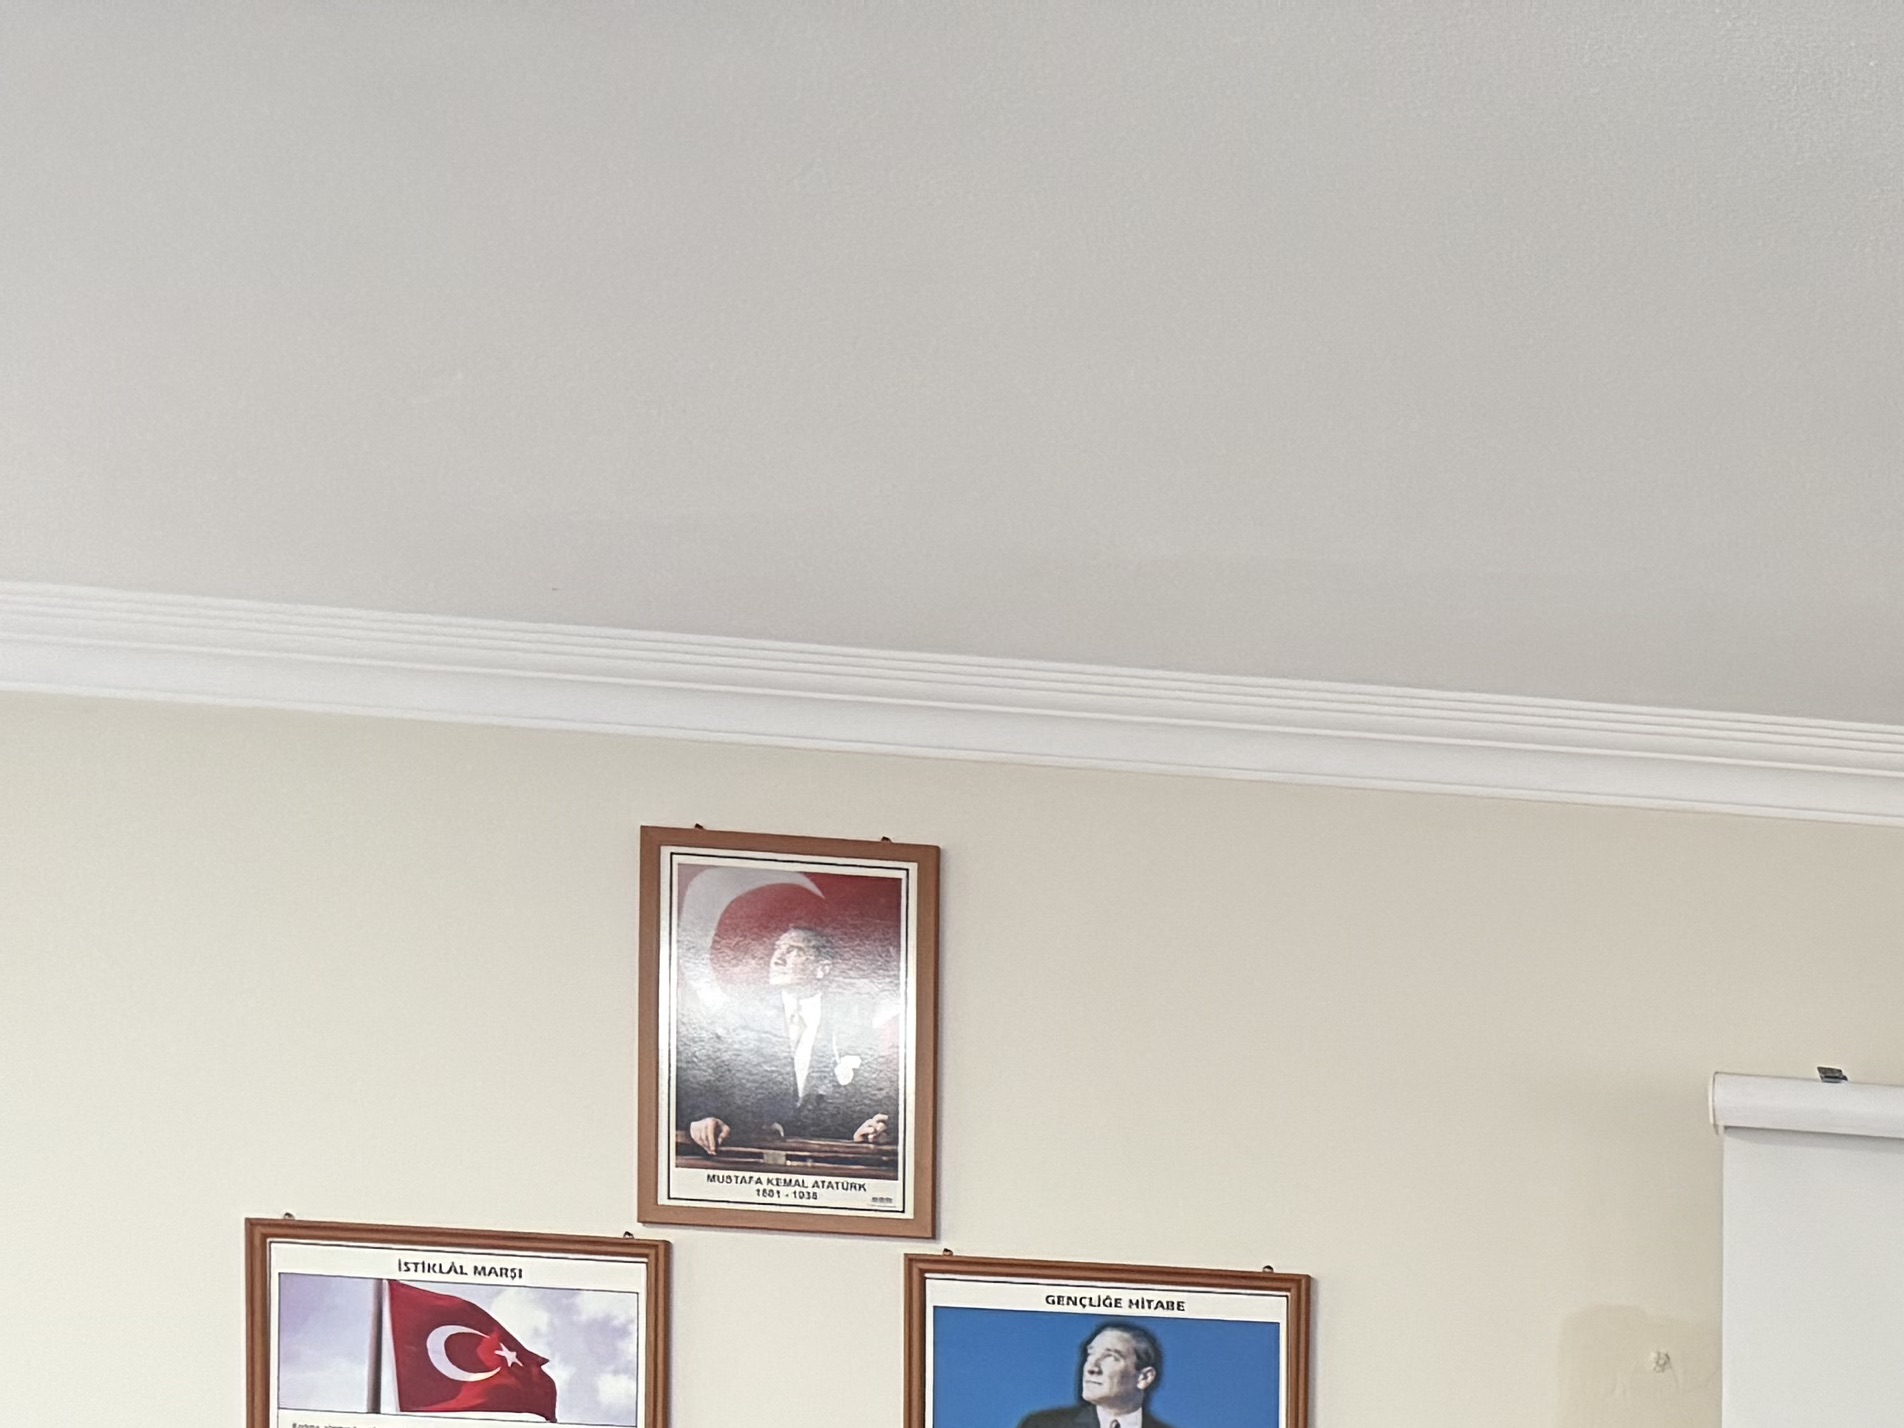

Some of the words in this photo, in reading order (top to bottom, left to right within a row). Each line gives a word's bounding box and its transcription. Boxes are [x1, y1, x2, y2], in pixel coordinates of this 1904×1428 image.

[707, 1174, 763, 1186] MUSTAFA
[767, 1177, 808, 1188] KEMAL
[812, 1180, 867, 1192] ATATÜRK
[474, 1266, 522, 1280] MARŞI
[1046, 1295, 1122, 1308] GENÇLİĞE
[1128, 1298, 1185, 1311] HİTABE
